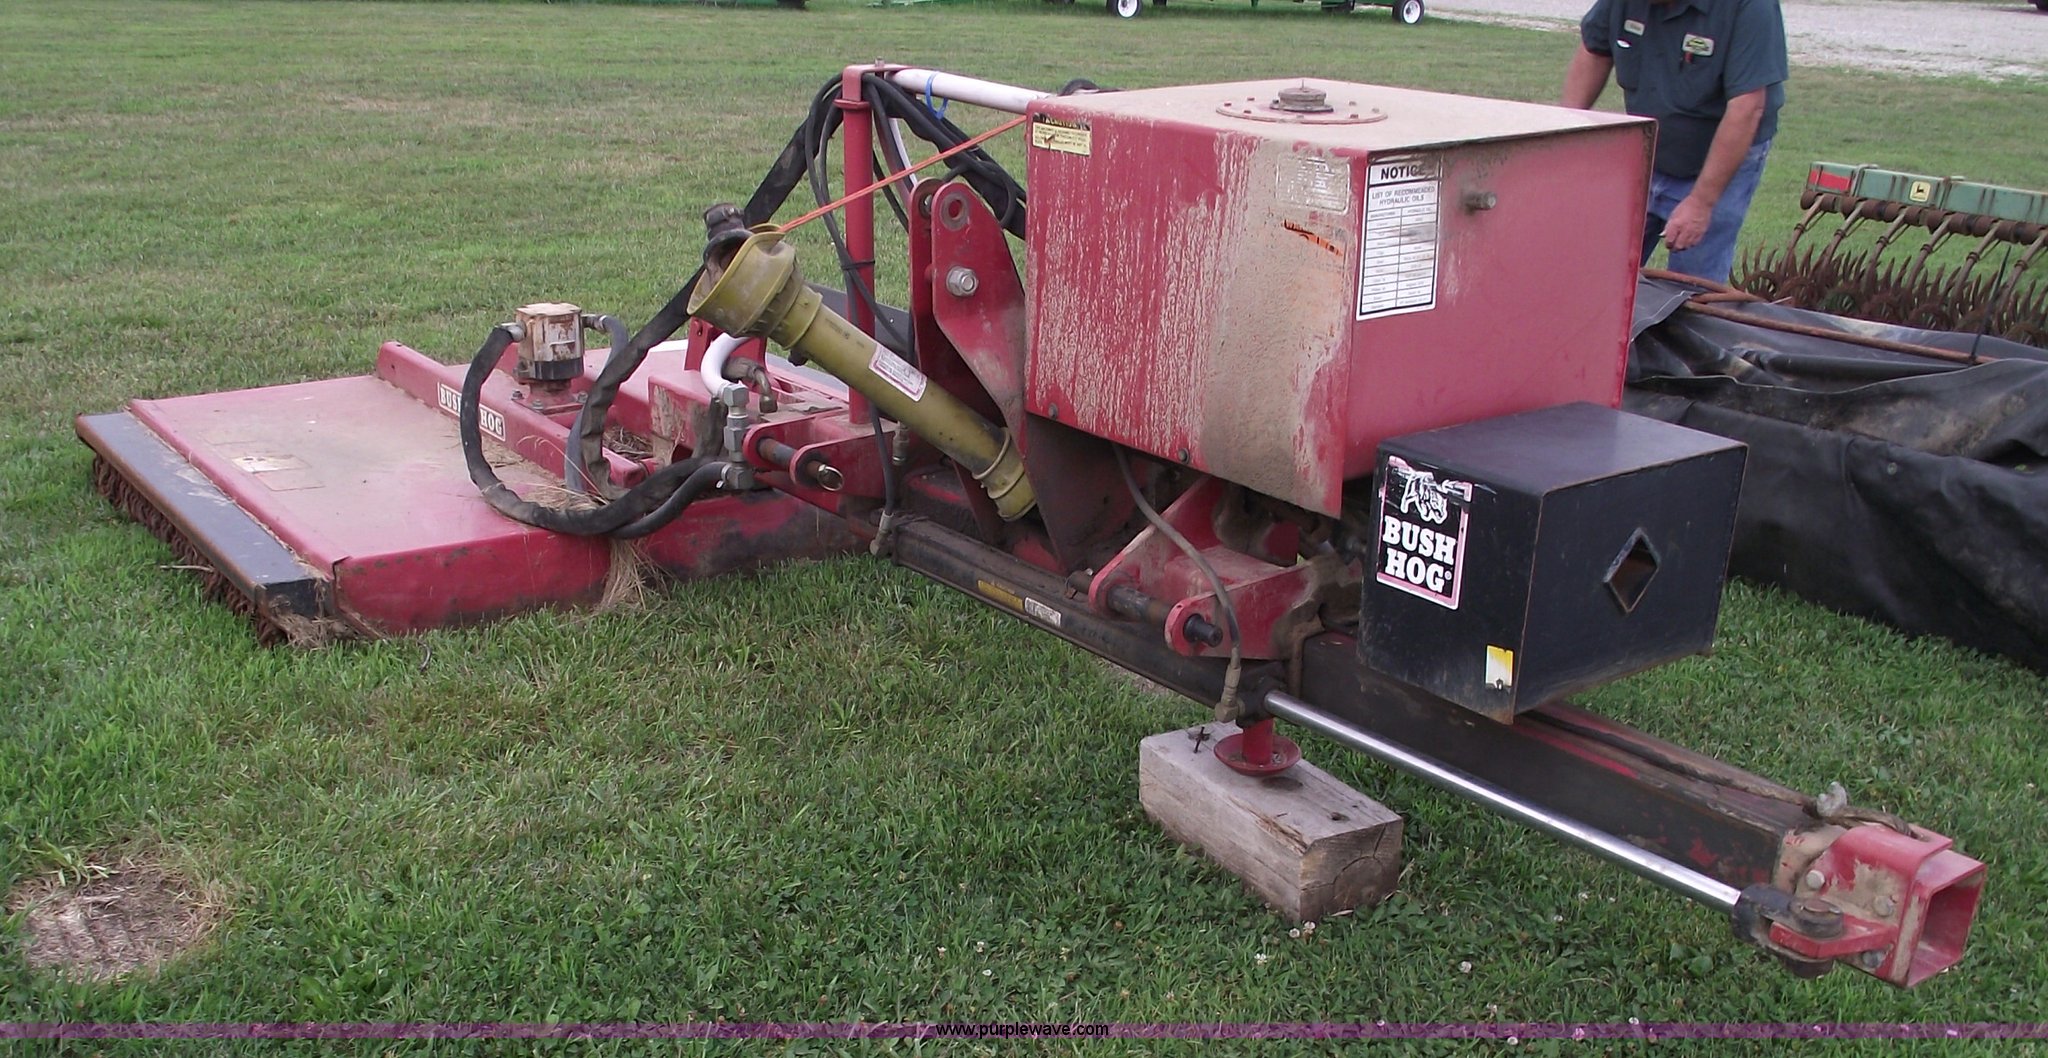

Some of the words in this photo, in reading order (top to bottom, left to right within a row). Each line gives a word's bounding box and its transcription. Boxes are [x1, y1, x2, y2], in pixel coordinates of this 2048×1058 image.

[1372, 191, 1383, 199] LIST
[1380, 196, 1409, 205] HYDRAULIC
[1412, 194, 1424, 202] OILS
[440, 387, 461, 413] BUS
[480, 408, 502, 435] HOG
[1383, 515, 1456, 565] BUSH
[1385, 548, 1445, 593] HOG
